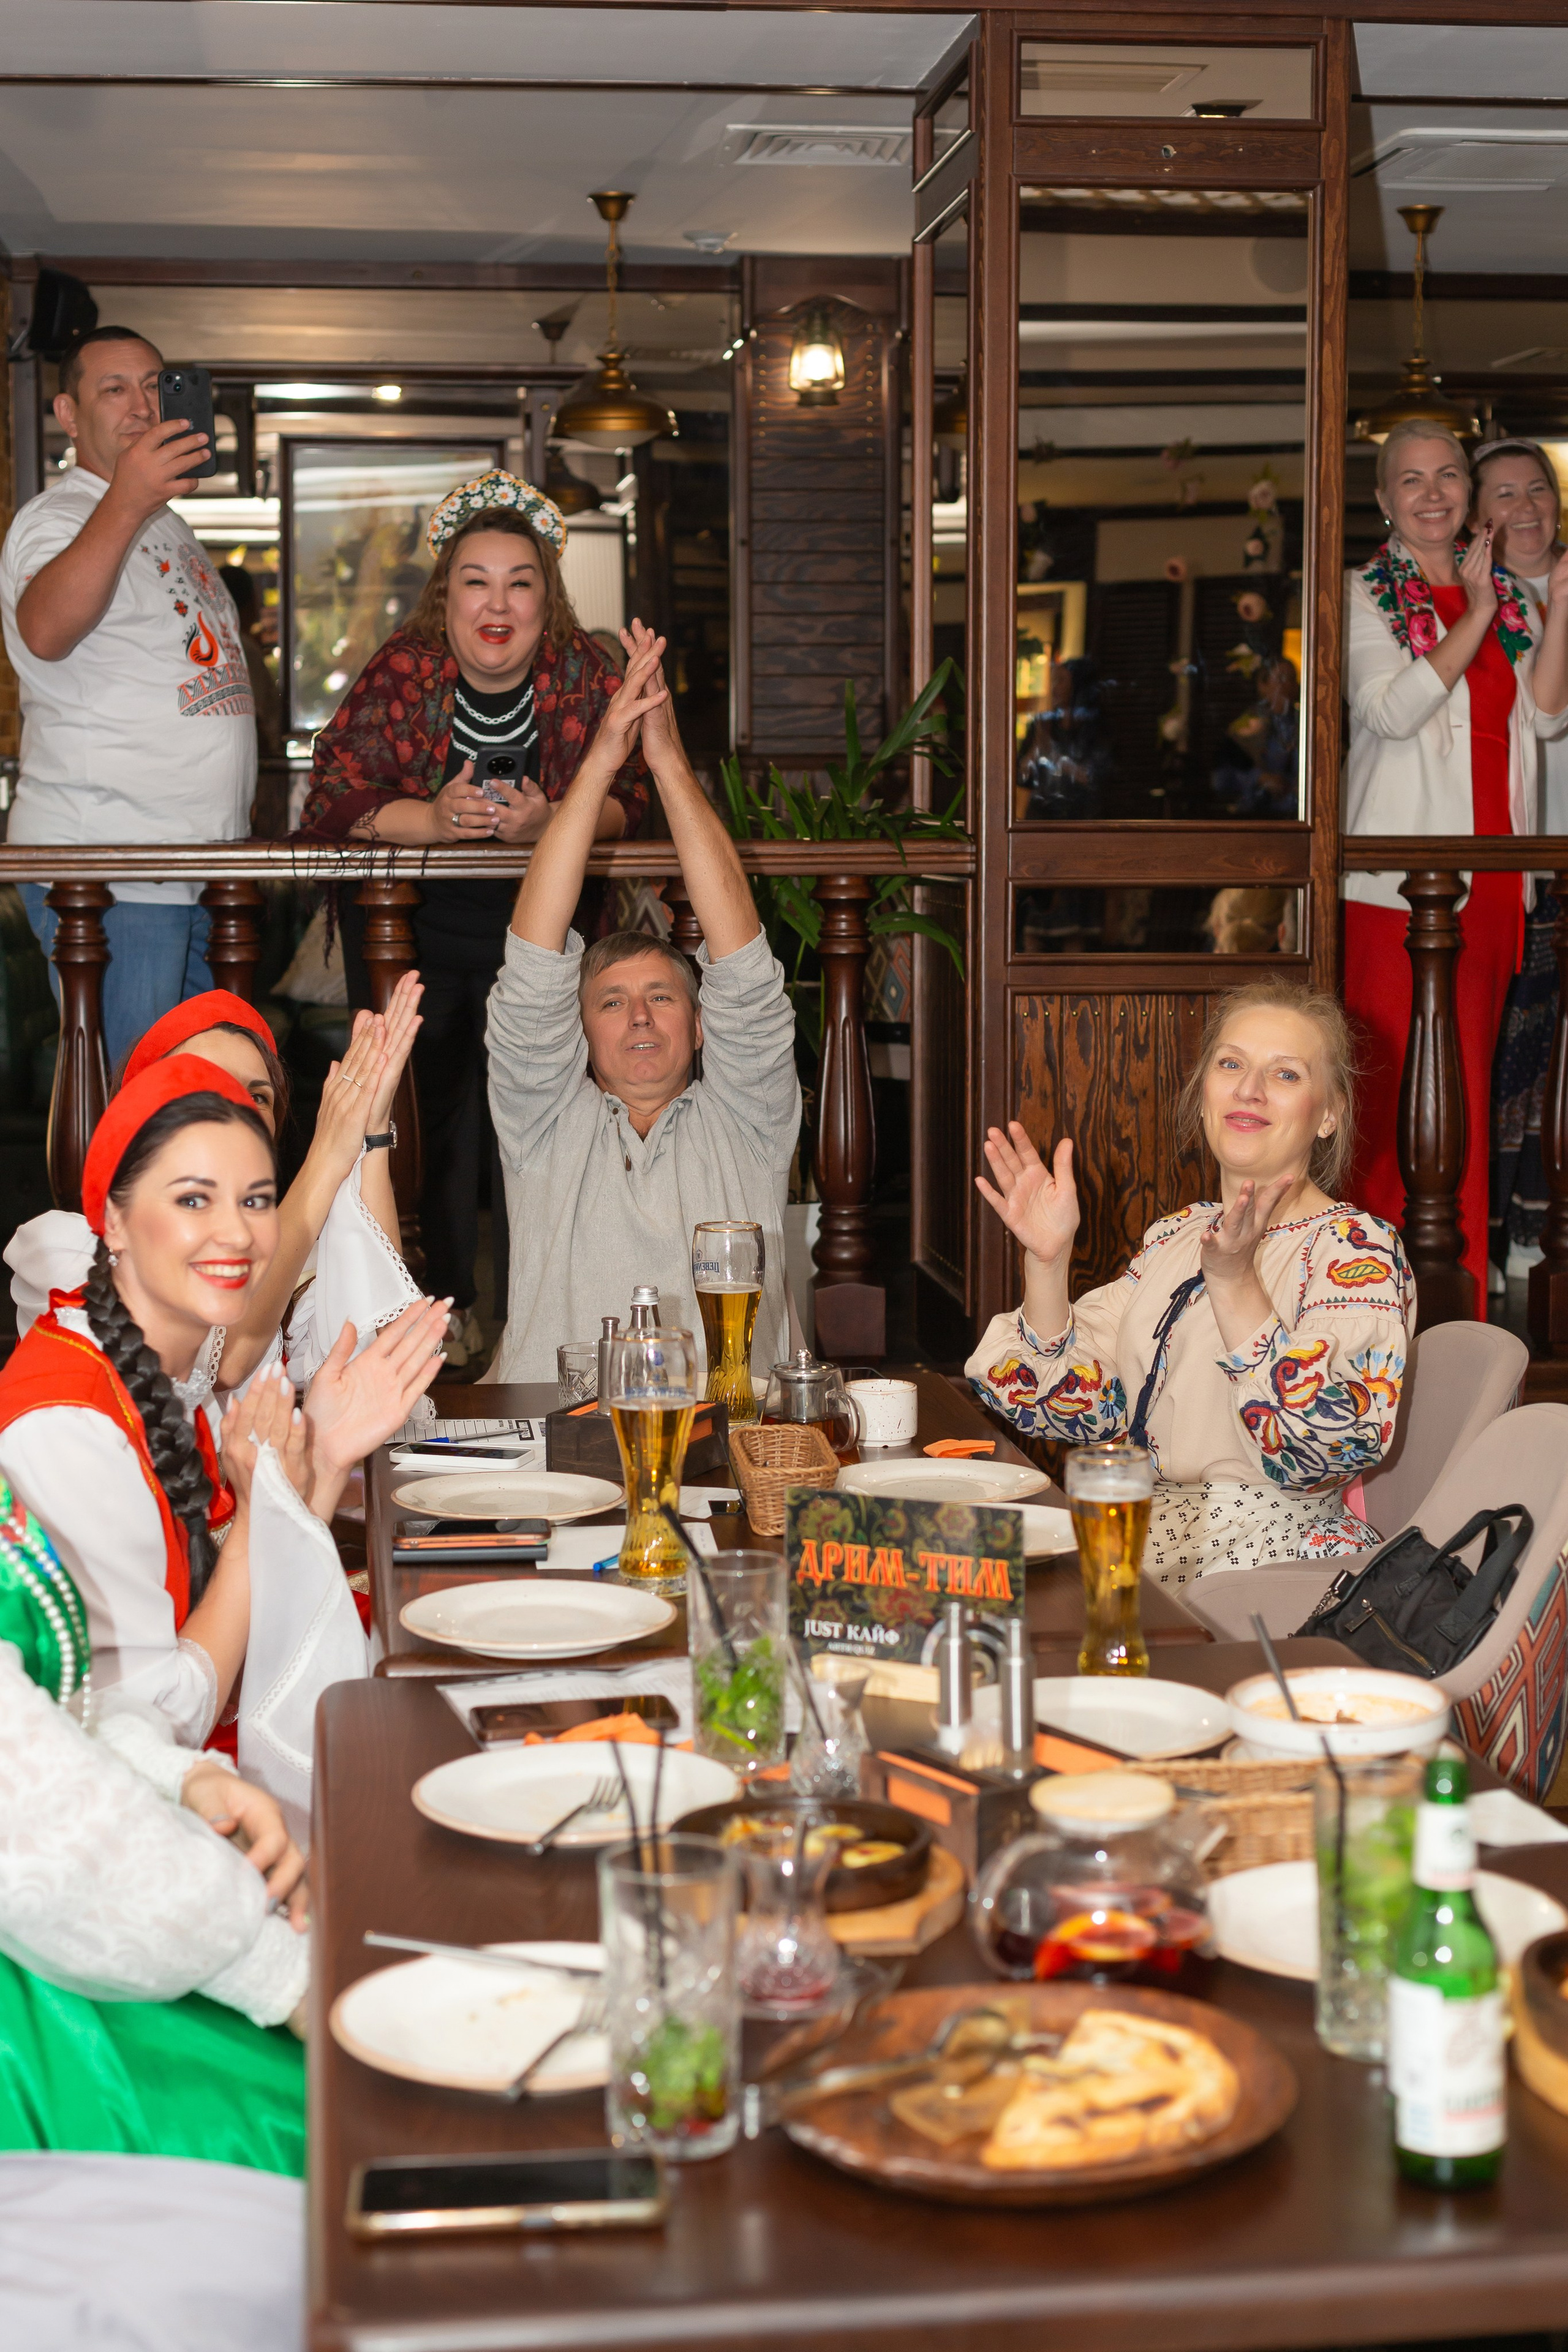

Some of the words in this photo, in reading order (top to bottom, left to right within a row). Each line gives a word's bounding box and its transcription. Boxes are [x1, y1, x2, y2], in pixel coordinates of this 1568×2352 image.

[796, 1538, 1014, 1601] ДРИМ-ТИМ
[803, 1619, 843, 1638] JUST
[846, 1623, 900, 1645] КАЙФ
